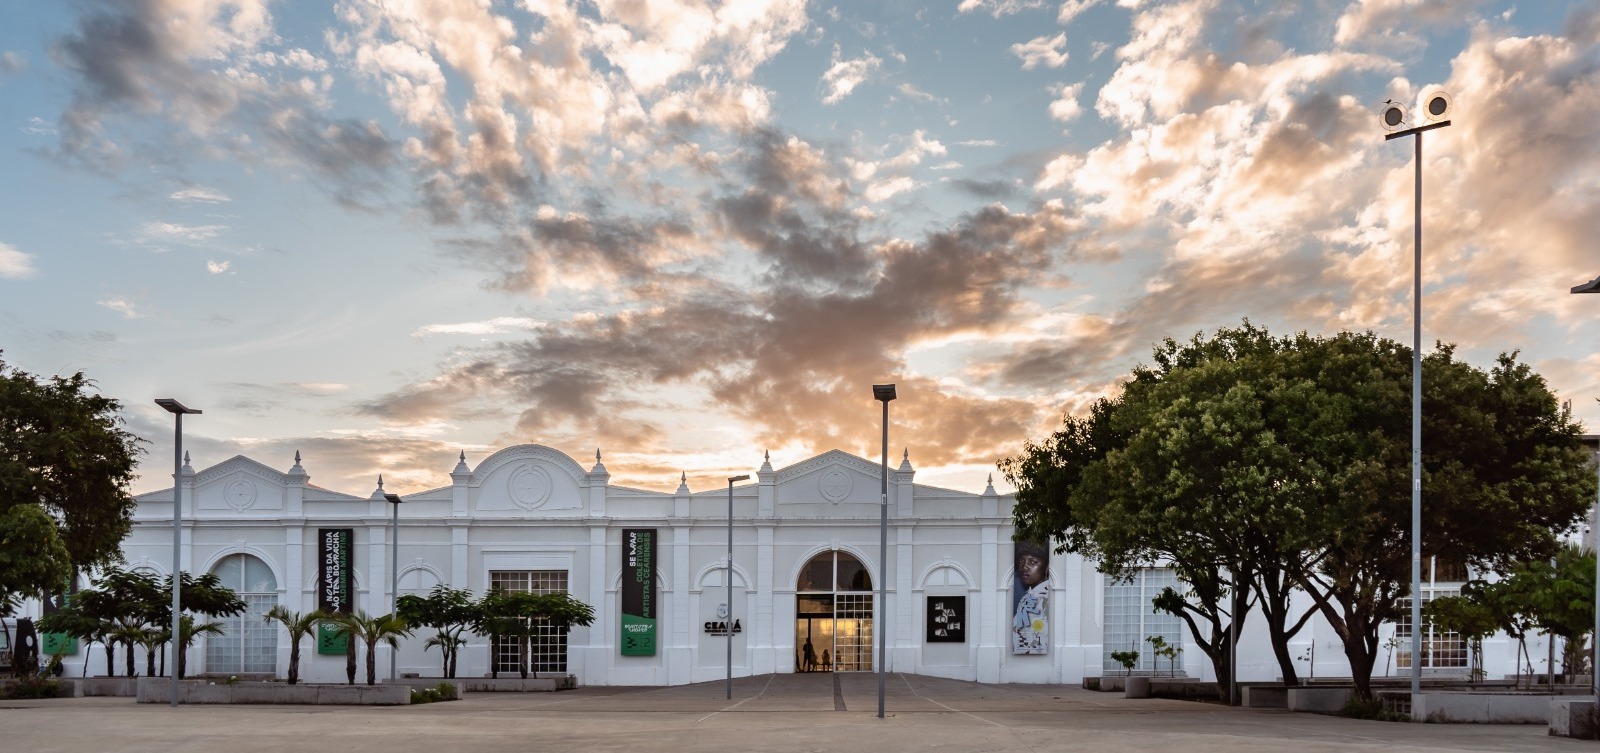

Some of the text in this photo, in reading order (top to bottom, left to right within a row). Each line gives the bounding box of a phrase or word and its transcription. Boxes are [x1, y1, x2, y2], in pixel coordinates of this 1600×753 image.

[637, 532, 643, 542] DE
[326, 553, 333, 564] DA
[630, 557, 636, 567] SE
[325, 565, 333, 589] LÁPIS
